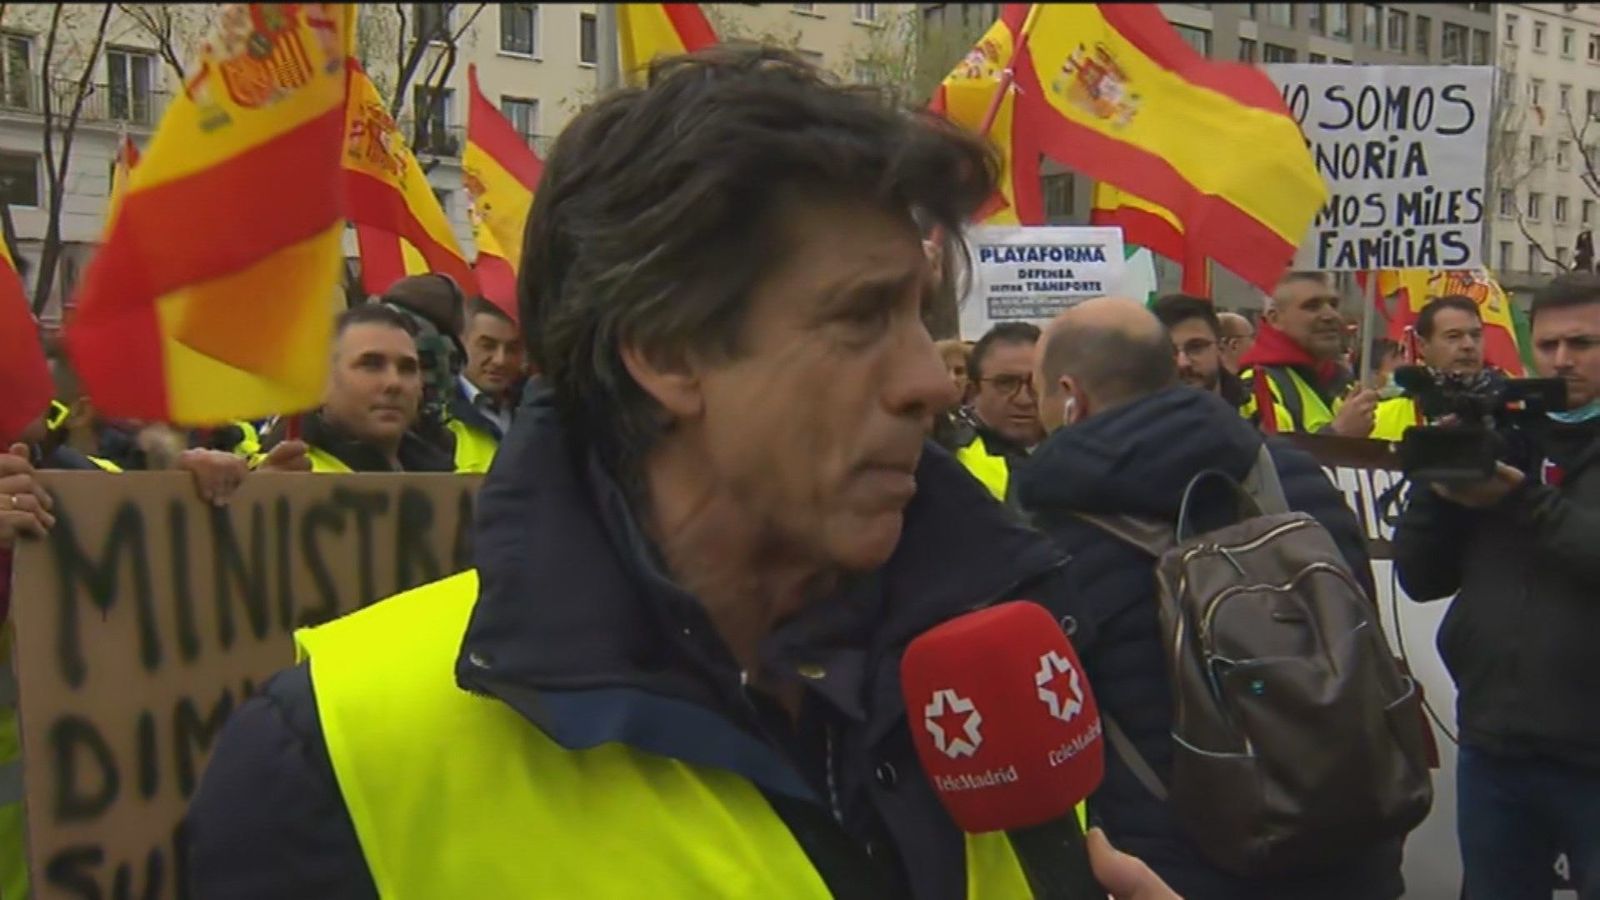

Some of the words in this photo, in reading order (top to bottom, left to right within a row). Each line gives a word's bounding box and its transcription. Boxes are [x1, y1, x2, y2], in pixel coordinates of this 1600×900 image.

[1318, 84, 1475, 135] SOMOS
[1314, 192, 1386, 228] MOS
[980, 247, 1106, 264] PLATAFORMA
[48, 678, 255, 826] DIM
[933, 764, 1019, 792] TeleMadrid
